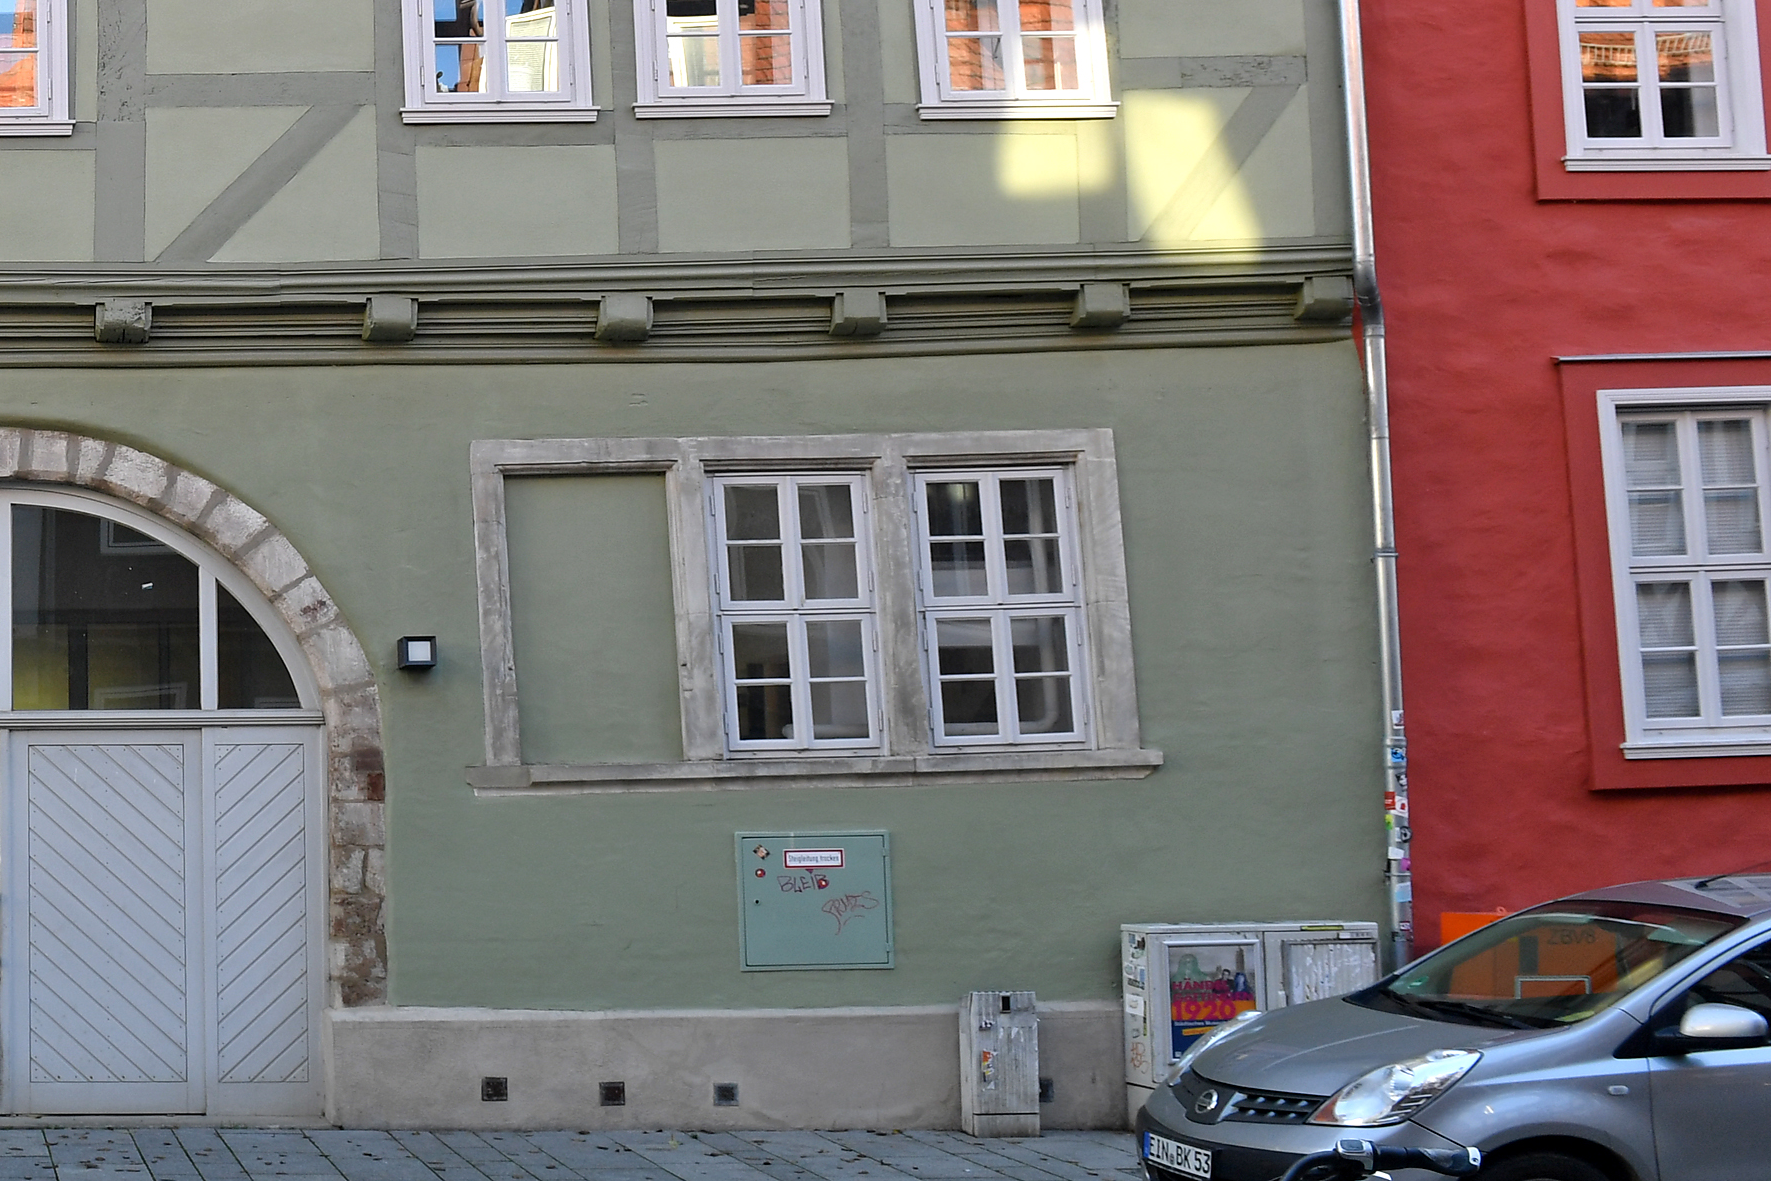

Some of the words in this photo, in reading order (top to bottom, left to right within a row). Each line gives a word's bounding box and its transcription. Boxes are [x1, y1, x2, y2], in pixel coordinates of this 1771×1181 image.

[820, 854, 840, 862] trocken
[1172, 1000, 1236, 1020] 1920
[1150, 1136, 1169, 1162] EIN
[1176, 1144, 1192, 1170] BK
[1194, 1151, 1211, 1174] 53
